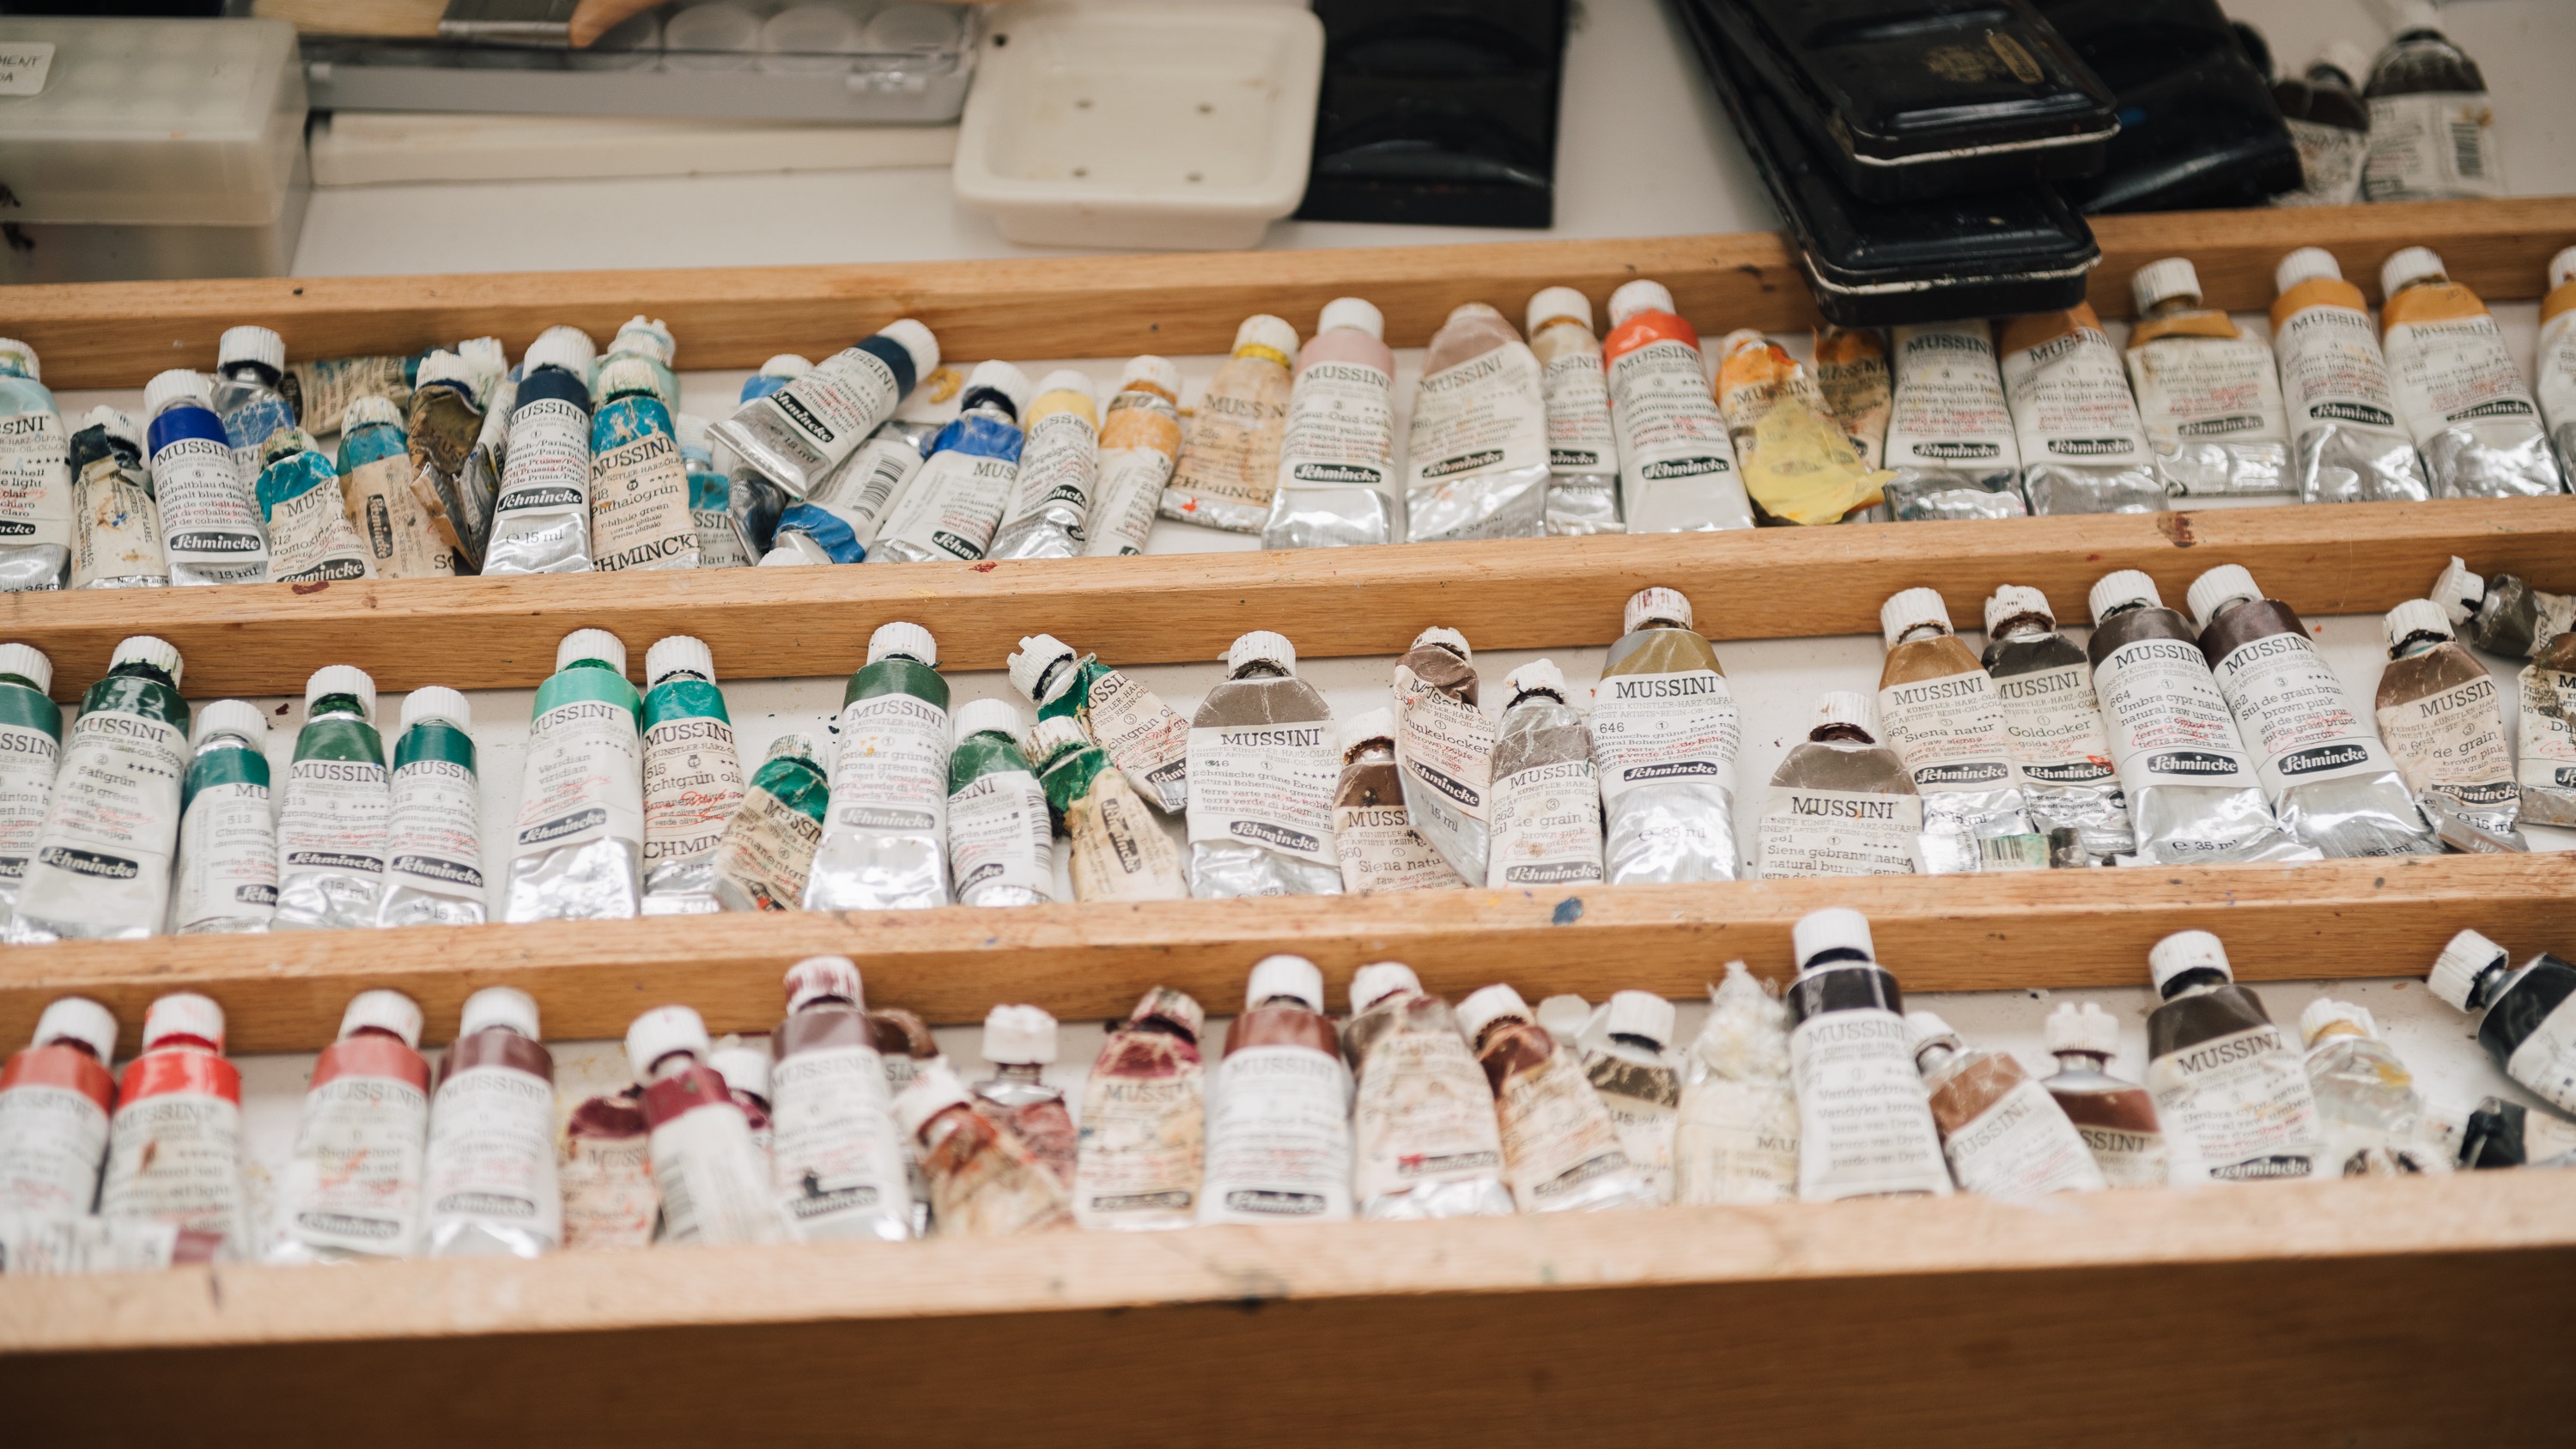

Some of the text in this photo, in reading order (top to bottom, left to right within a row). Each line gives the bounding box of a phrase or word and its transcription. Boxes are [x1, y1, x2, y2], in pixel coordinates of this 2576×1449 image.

[1615, 676, 1717, 699] MUSSINI
[1893, 676, 1984, 706] MUSSINI
[1599, 721, 1625, 734] 646
[1625, 763, 1716, 781] Schmincke
[2149, 753, 2237, 773] Schmincke
[2280, 746, 2367, 775] Schmincke
[1231, 821, 1319, 851] Schmincke
